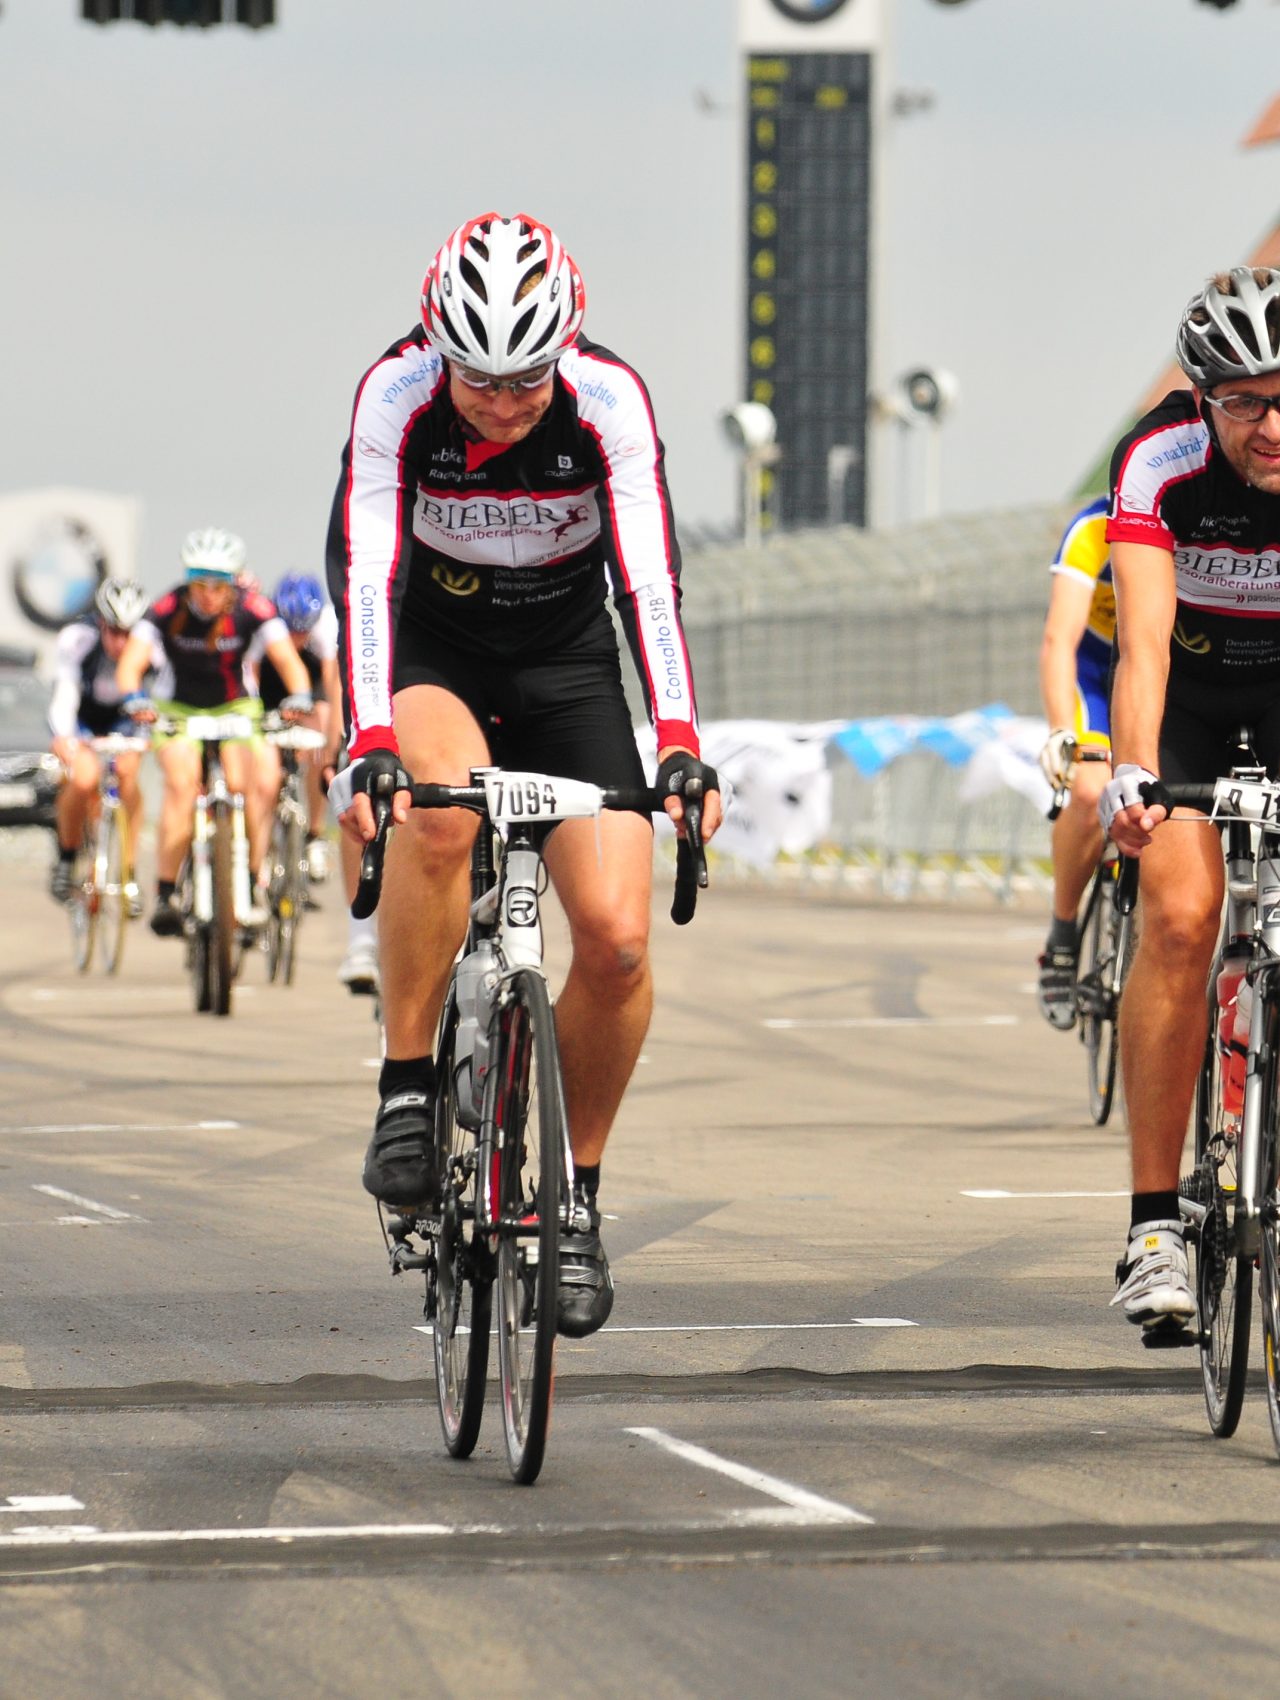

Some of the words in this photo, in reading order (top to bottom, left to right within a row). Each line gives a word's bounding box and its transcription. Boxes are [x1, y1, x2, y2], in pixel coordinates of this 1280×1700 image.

[421, 499, 561, 530] BIEBER
[360, 584, 379, 657] Consalto
[649, 597, 668, 621] StB
[1225, 638, 1274, 647] Deutsche
[656, 625, 682, 700] Consalto
[492, 781, 557, 817] 7094
